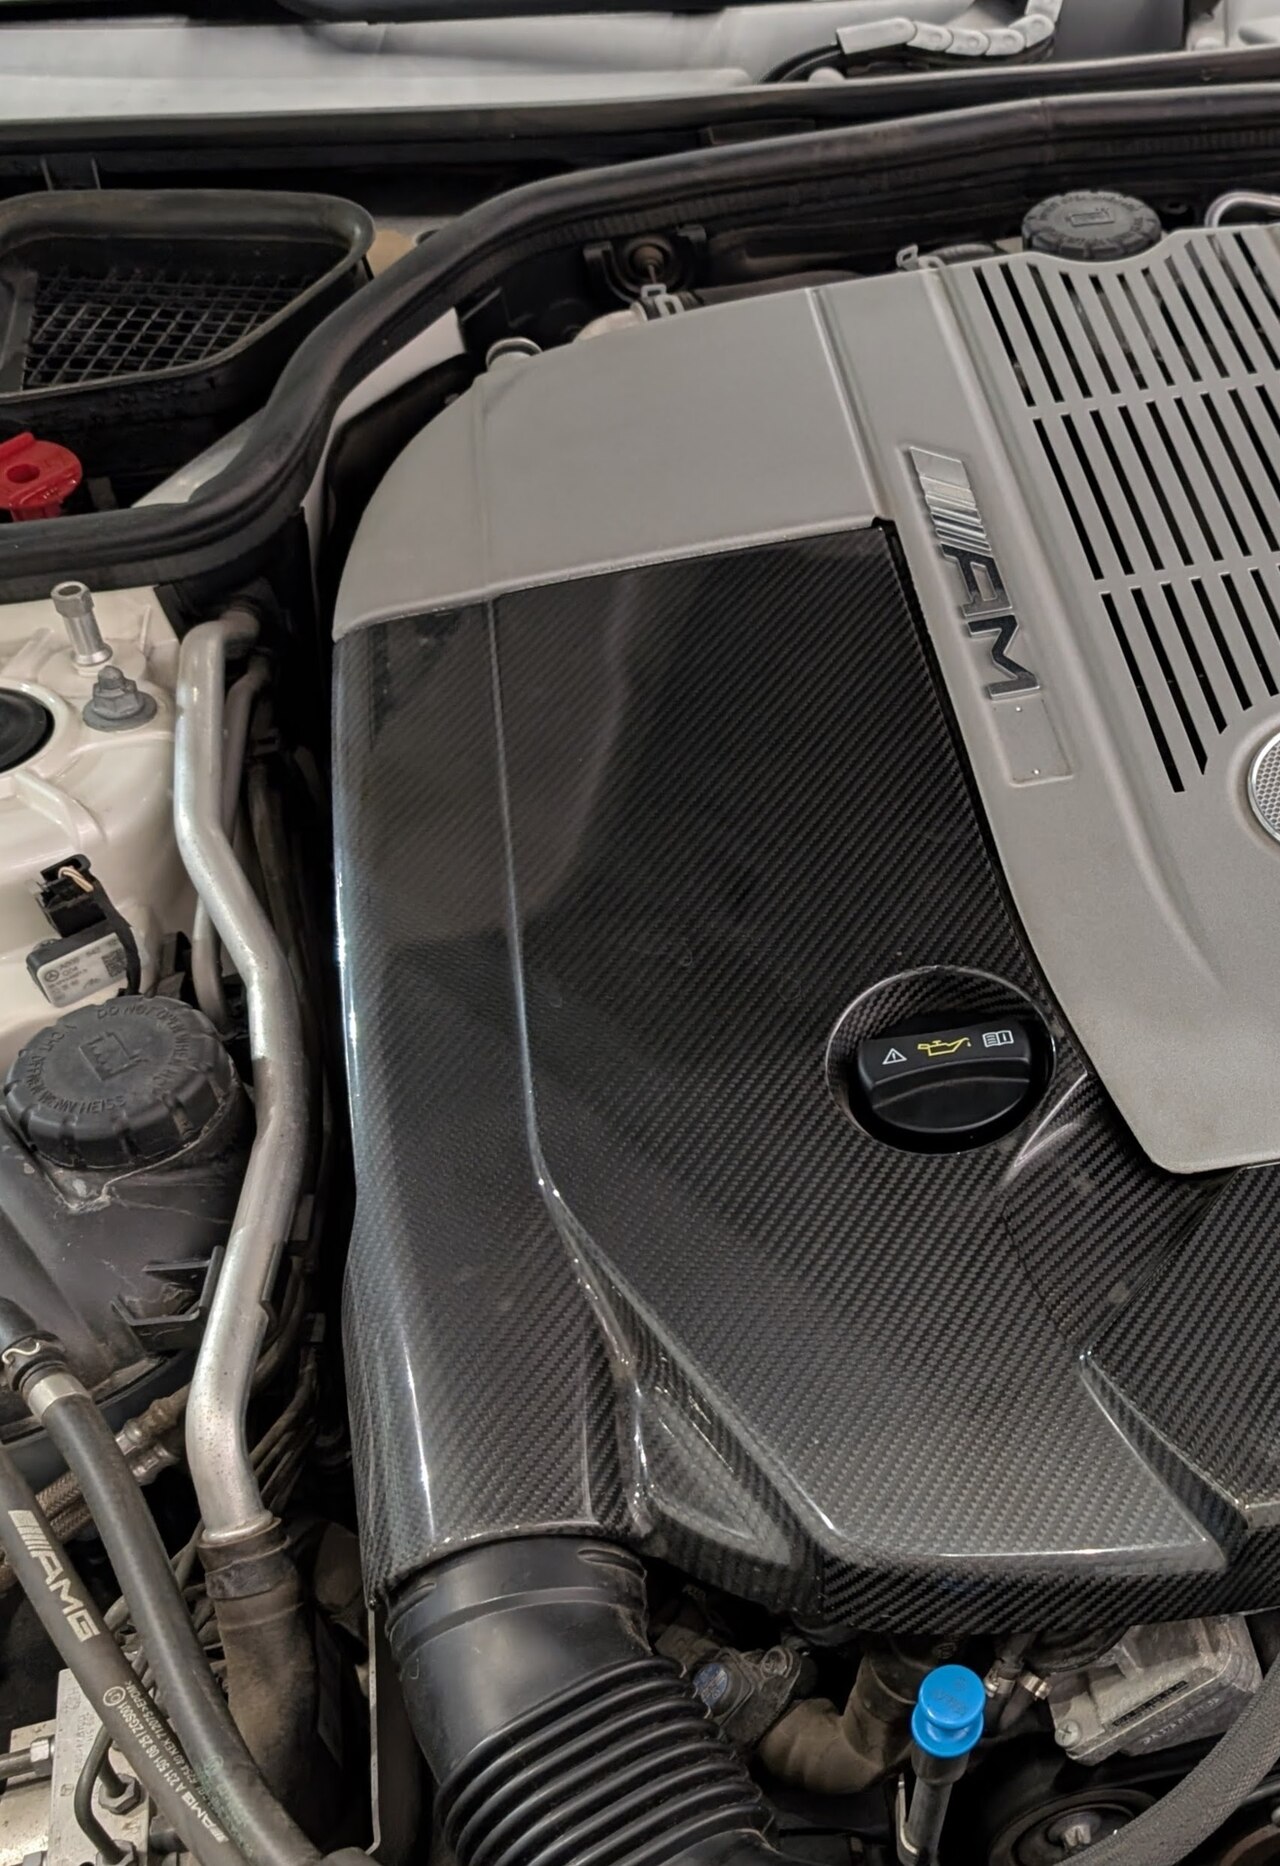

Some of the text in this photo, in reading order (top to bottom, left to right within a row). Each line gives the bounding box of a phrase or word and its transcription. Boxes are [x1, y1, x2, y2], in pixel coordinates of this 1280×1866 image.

[97, 1005, 120, 1019] DO
[29, 1550, 101, 1643] AMG
[153, 1755, 171, 1772] 501
[163, 1769, 181, 1787] 231
